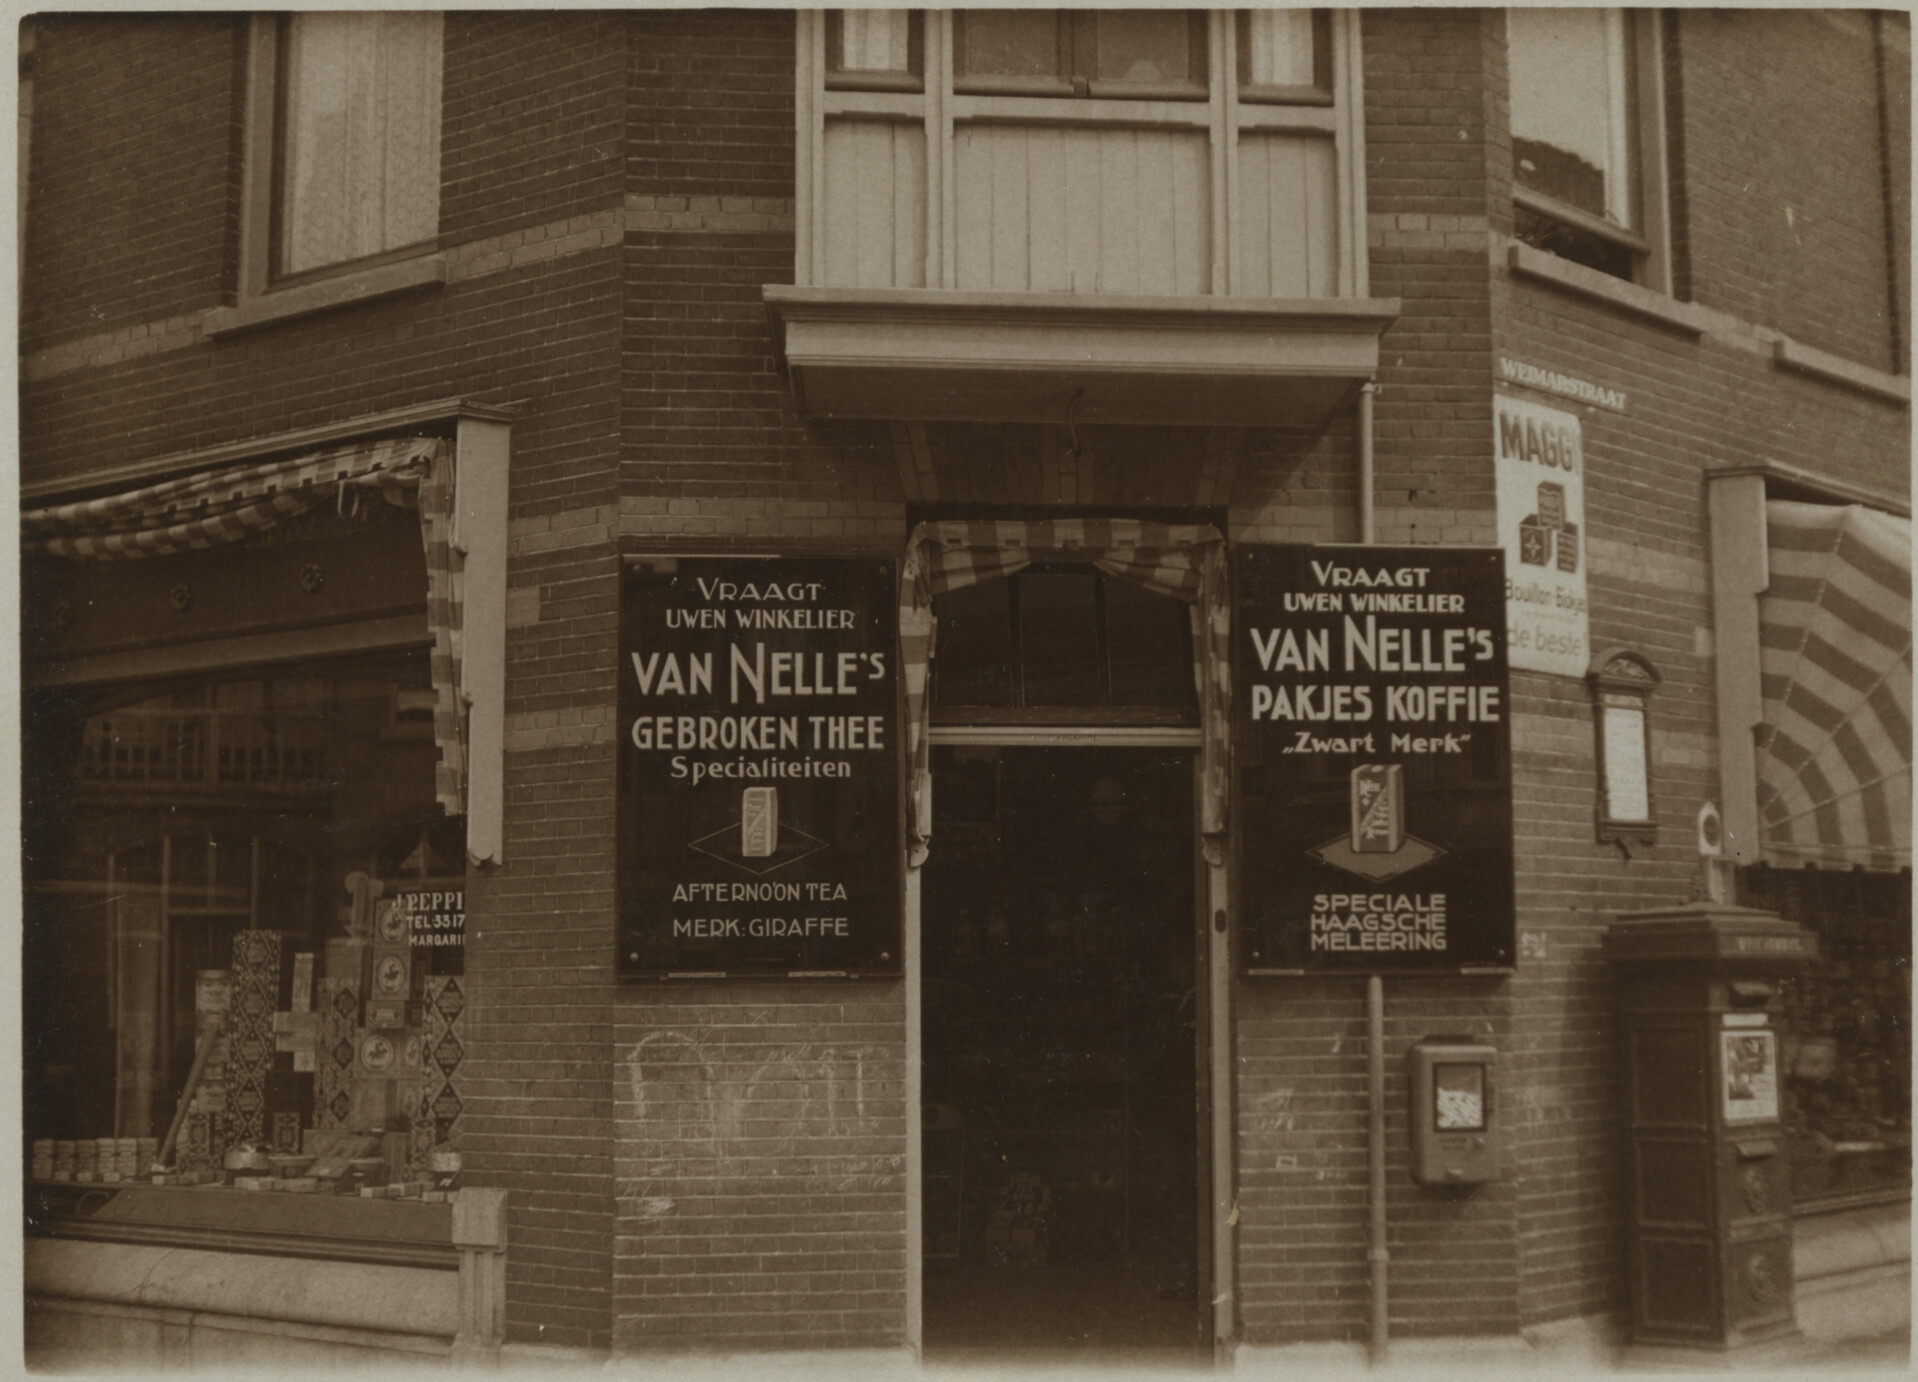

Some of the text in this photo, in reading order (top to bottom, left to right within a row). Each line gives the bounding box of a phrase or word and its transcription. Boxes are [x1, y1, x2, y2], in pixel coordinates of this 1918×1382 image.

[1500, 357, 1627, 410] WEIMARSTRAAT
[1311, 560, 1430, 587] VRAAGT
[697, 577, 822, 601] VRAAGT
[1284, 592, 1465, 613] UWEN WINKELIER
[666, 608, 855, 629] UWEN WINKELIER
[1250, 615, 1494, 672] VAN NELLE'S
[1508, 621, 1582, 656] de beste
[631, 642, 885, 704] VAN NELLE'S
[1252, 685, 1500, 722] PAKJES KOFFIE
[631, 716, 884, 750] GEBROKEN THEE
[670, 756, 851, 787] Specialiteiten
[806, 882, 848, 901] TEA
[1313, 894, 1446, 912] SPECIALE
[1311, 913, 1446, 931] HAAGSCHE
[1311, 931, 1446, 951] MELEERING
